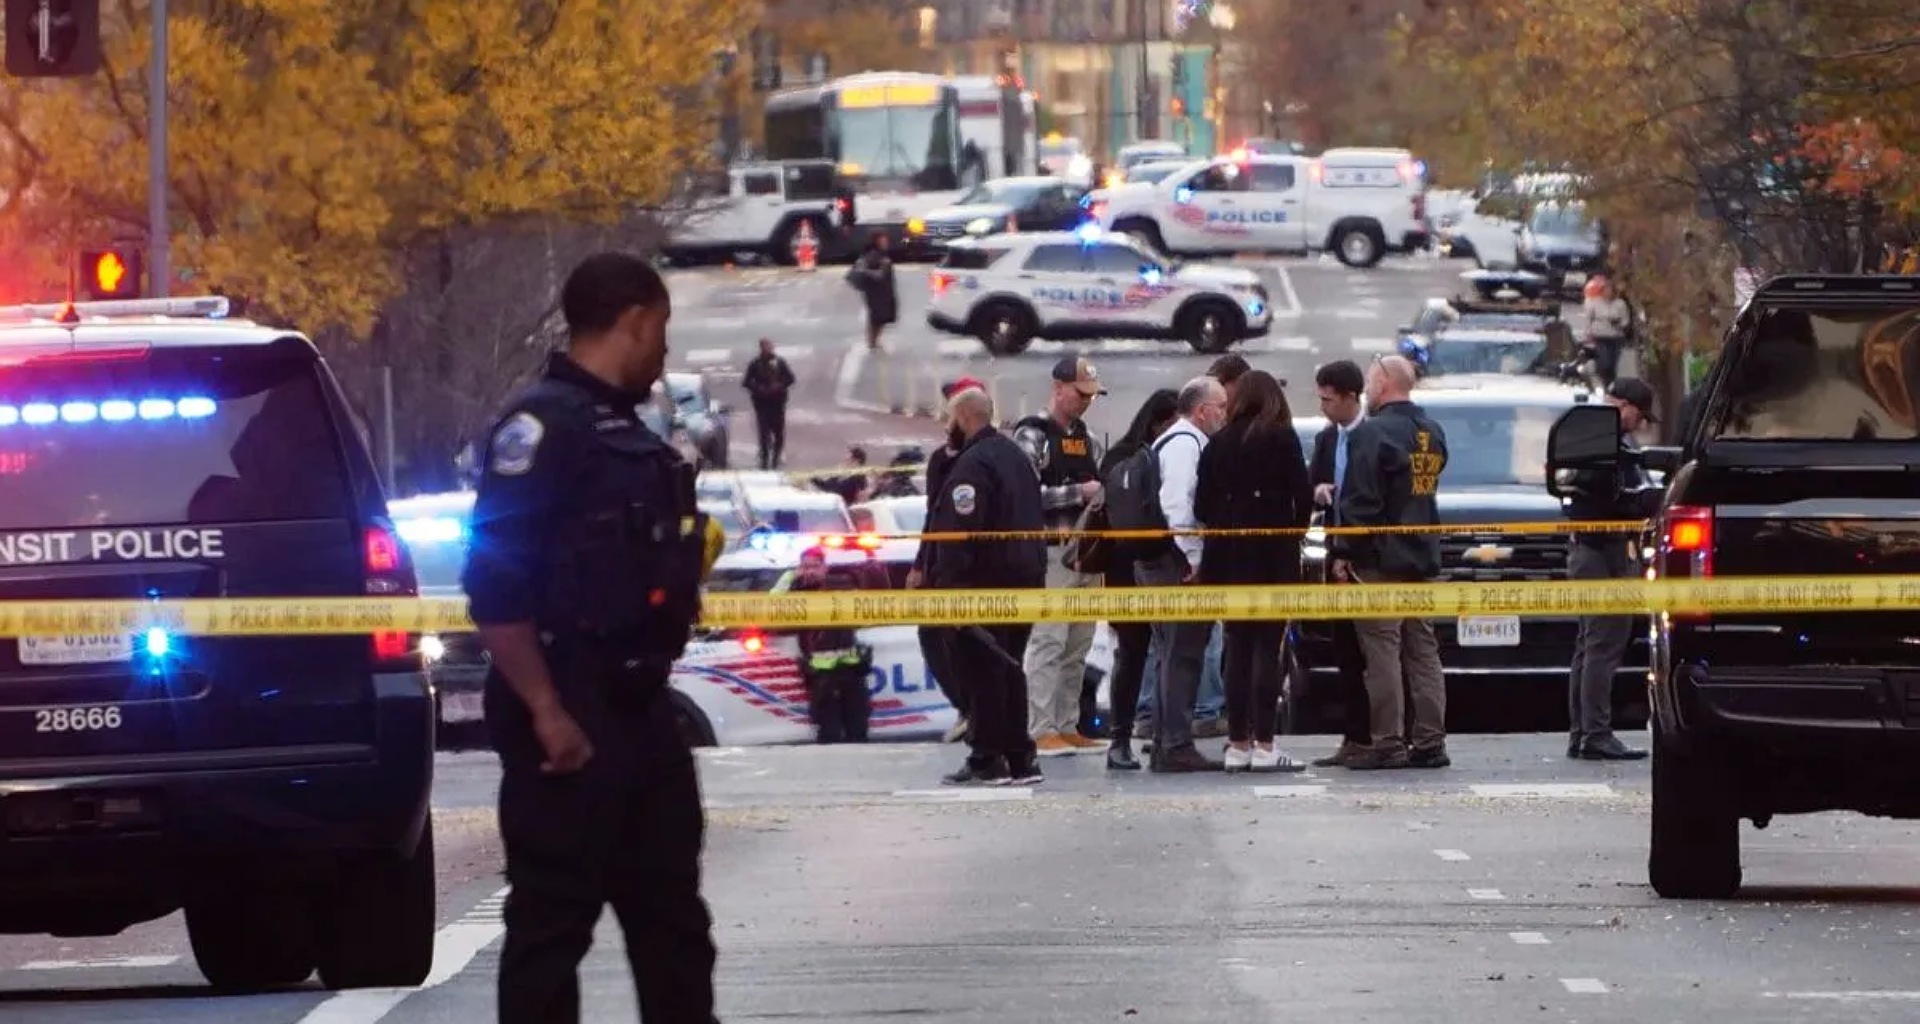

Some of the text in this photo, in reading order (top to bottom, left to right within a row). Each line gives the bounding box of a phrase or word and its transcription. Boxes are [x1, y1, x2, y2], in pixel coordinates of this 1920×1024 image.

[1205, 210, 1288, 223] POLICE
[0, 529, 225, 562] NSIT POLICE
[853, 597, 896, 620] POLICE
[930, 596, 945, 619] DO
[950, 595, 974, 619] NOT
[977, 594, 1019, 619] CROSS
[1107, 593, 1135, 615] LINE
[1158, 592, 1183, 615] NOT
[1187, 591, 1228, 614] CROSS
[866, 664, 936, 694] OLI
[36, 705, 122, 732] 28666
